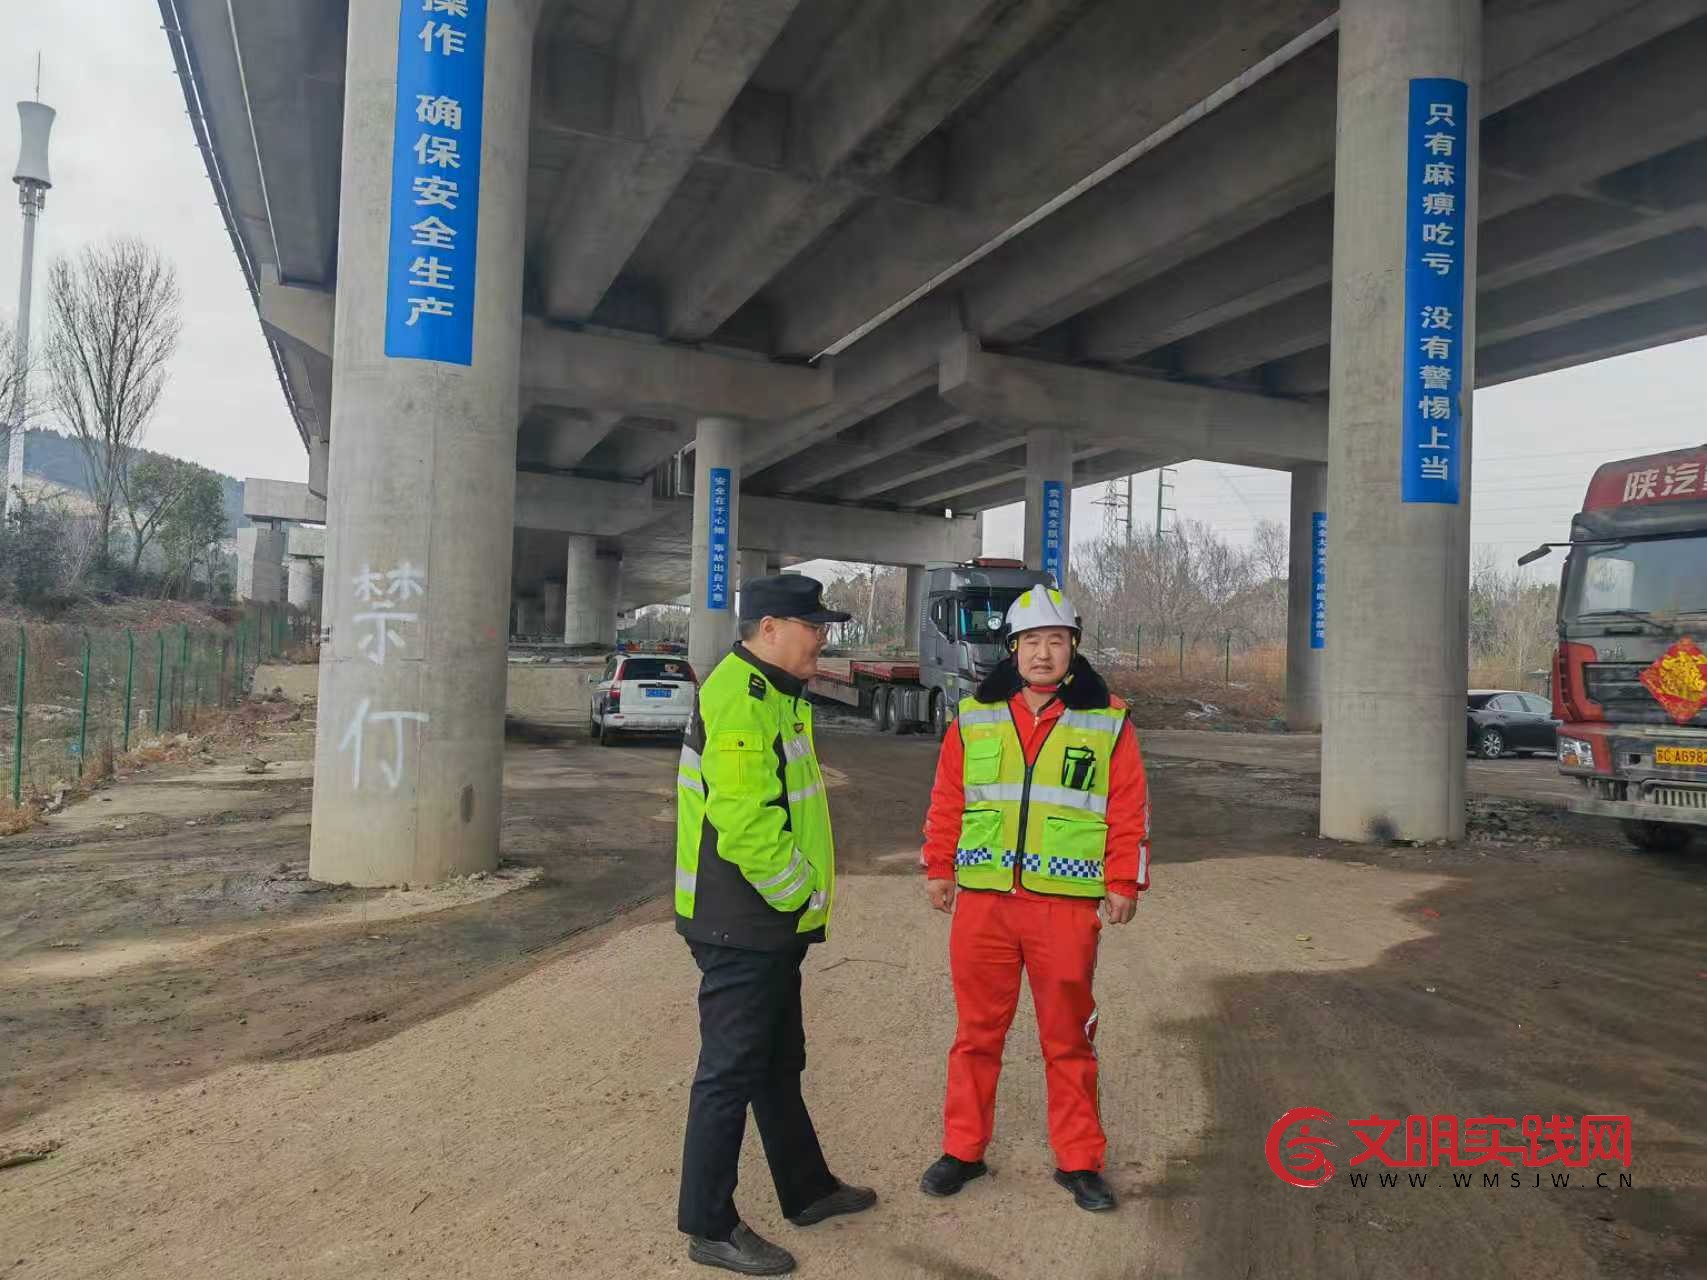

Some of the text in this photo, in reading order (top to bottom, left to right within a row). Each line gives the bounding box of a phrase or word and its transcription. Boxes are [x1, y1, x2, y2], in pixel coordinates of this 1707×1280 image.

[405, 94, 463, 327] 确保安全生产
[1418, 103, 1456, 480] 只有麻痹吃亏 没有警惕上当
[1622, 463, 1707, 503] 陕汽
